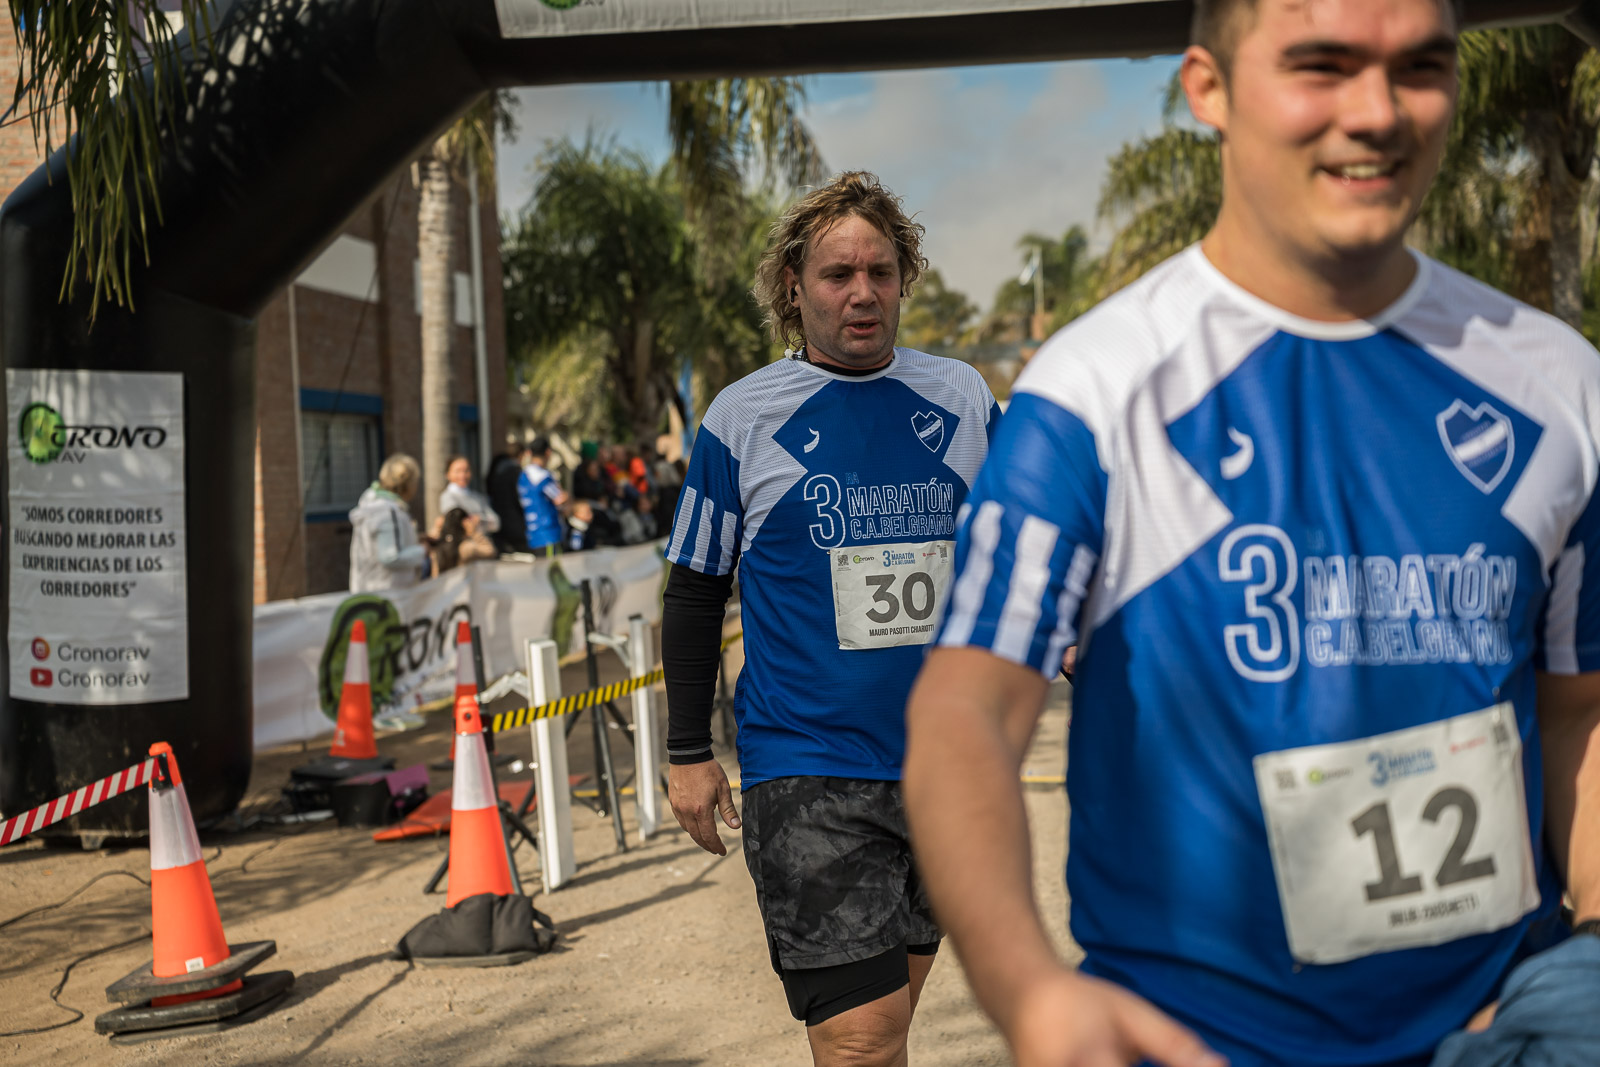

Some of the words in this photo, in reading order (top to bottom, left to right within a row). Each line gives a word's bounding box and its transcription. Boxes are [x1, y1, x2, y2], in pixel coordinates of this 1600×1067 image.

[846, 477, 954, 517] MARATÓN
[67, 507, 163, 525] CORREDORES
[803, 473, 846, 550] 3
[14, 528, 73, 548] BUSCANDO
[76, 531, 146, 549] MEJORAR
[150, 531, 176, 548] LAS
[22, 553, 110, 573] EXPERIENCIAS
[113, 557, 133, 573] DE
[136, 555, 163, 572] LOS
[865, 571, 936, 624] 30
[1218, 523, 1301, 683] 3
[869, 627, 889, 637] MAURO
[889, 626, 910, 635] PASOTTI
[57, 642, 151, 662] Cronorav
[57, 668, 151, 688] Cronorav
[1350, 785, 1497, 903] 12
